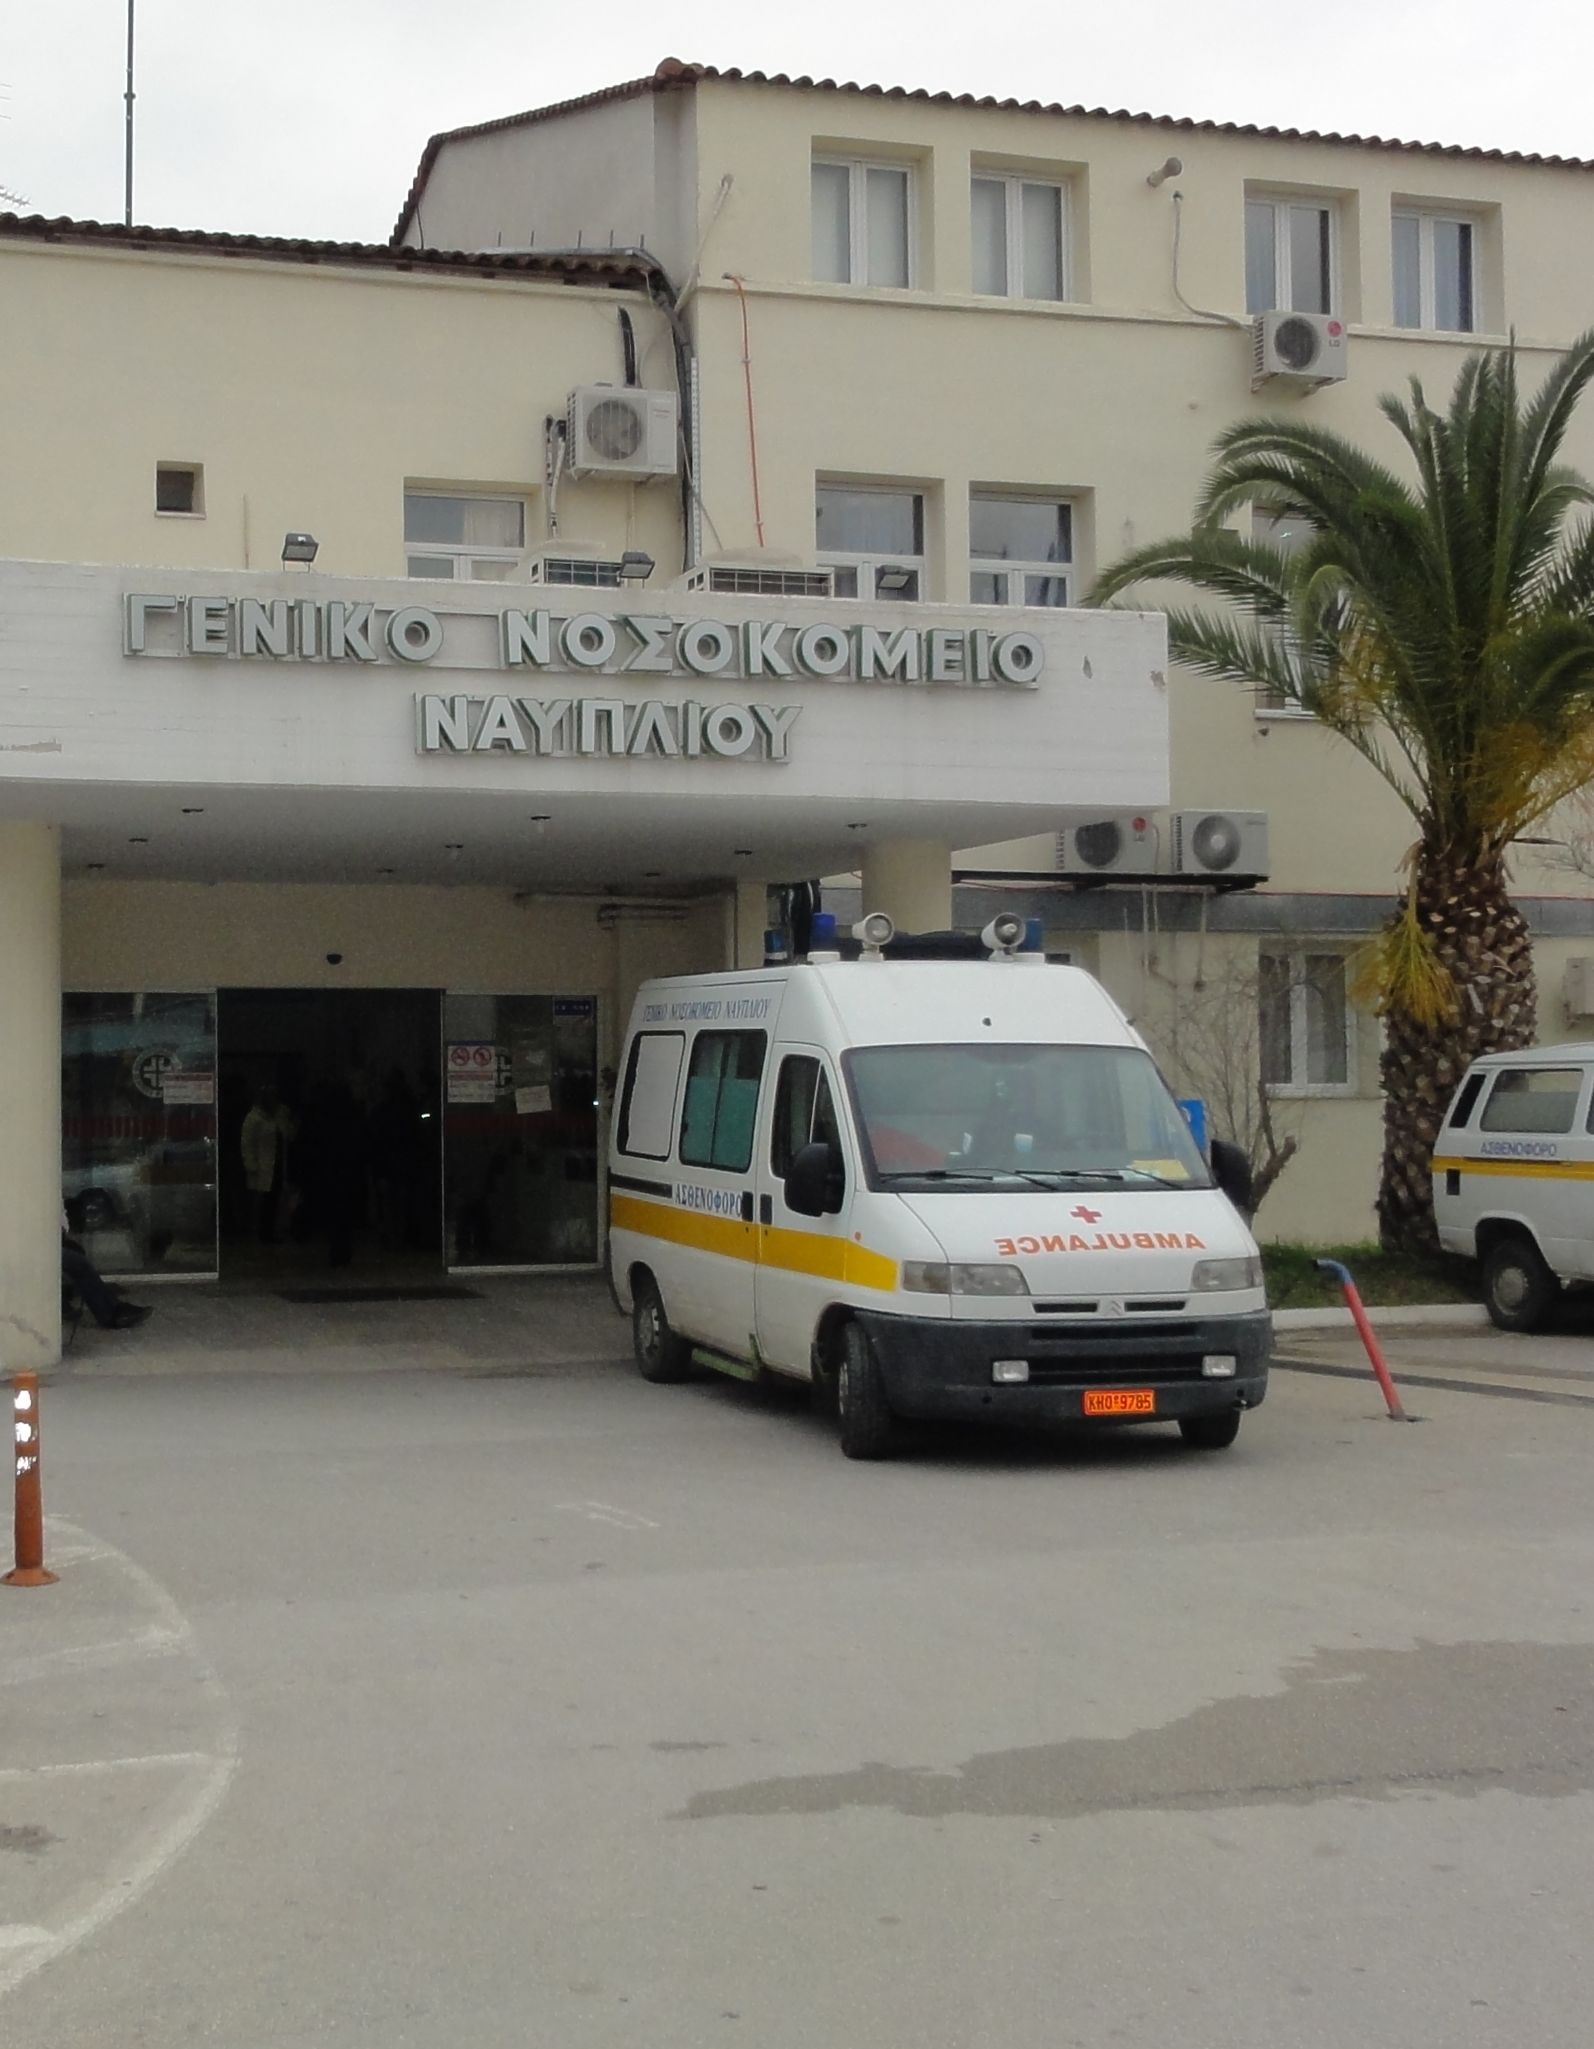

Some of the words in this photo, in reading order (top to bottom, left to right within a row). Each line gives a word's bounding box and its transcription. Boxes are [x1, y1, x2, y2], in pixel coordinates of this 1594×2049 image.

[127, 593, 444, 663] ΓΕΝΙΚΟ
[501, 608, 1045, 684] ΝΟΣΟΚΟΜΕΙΟ
[419, 694, 803, 759] ΝΑΥΠΛΙΟΥ
